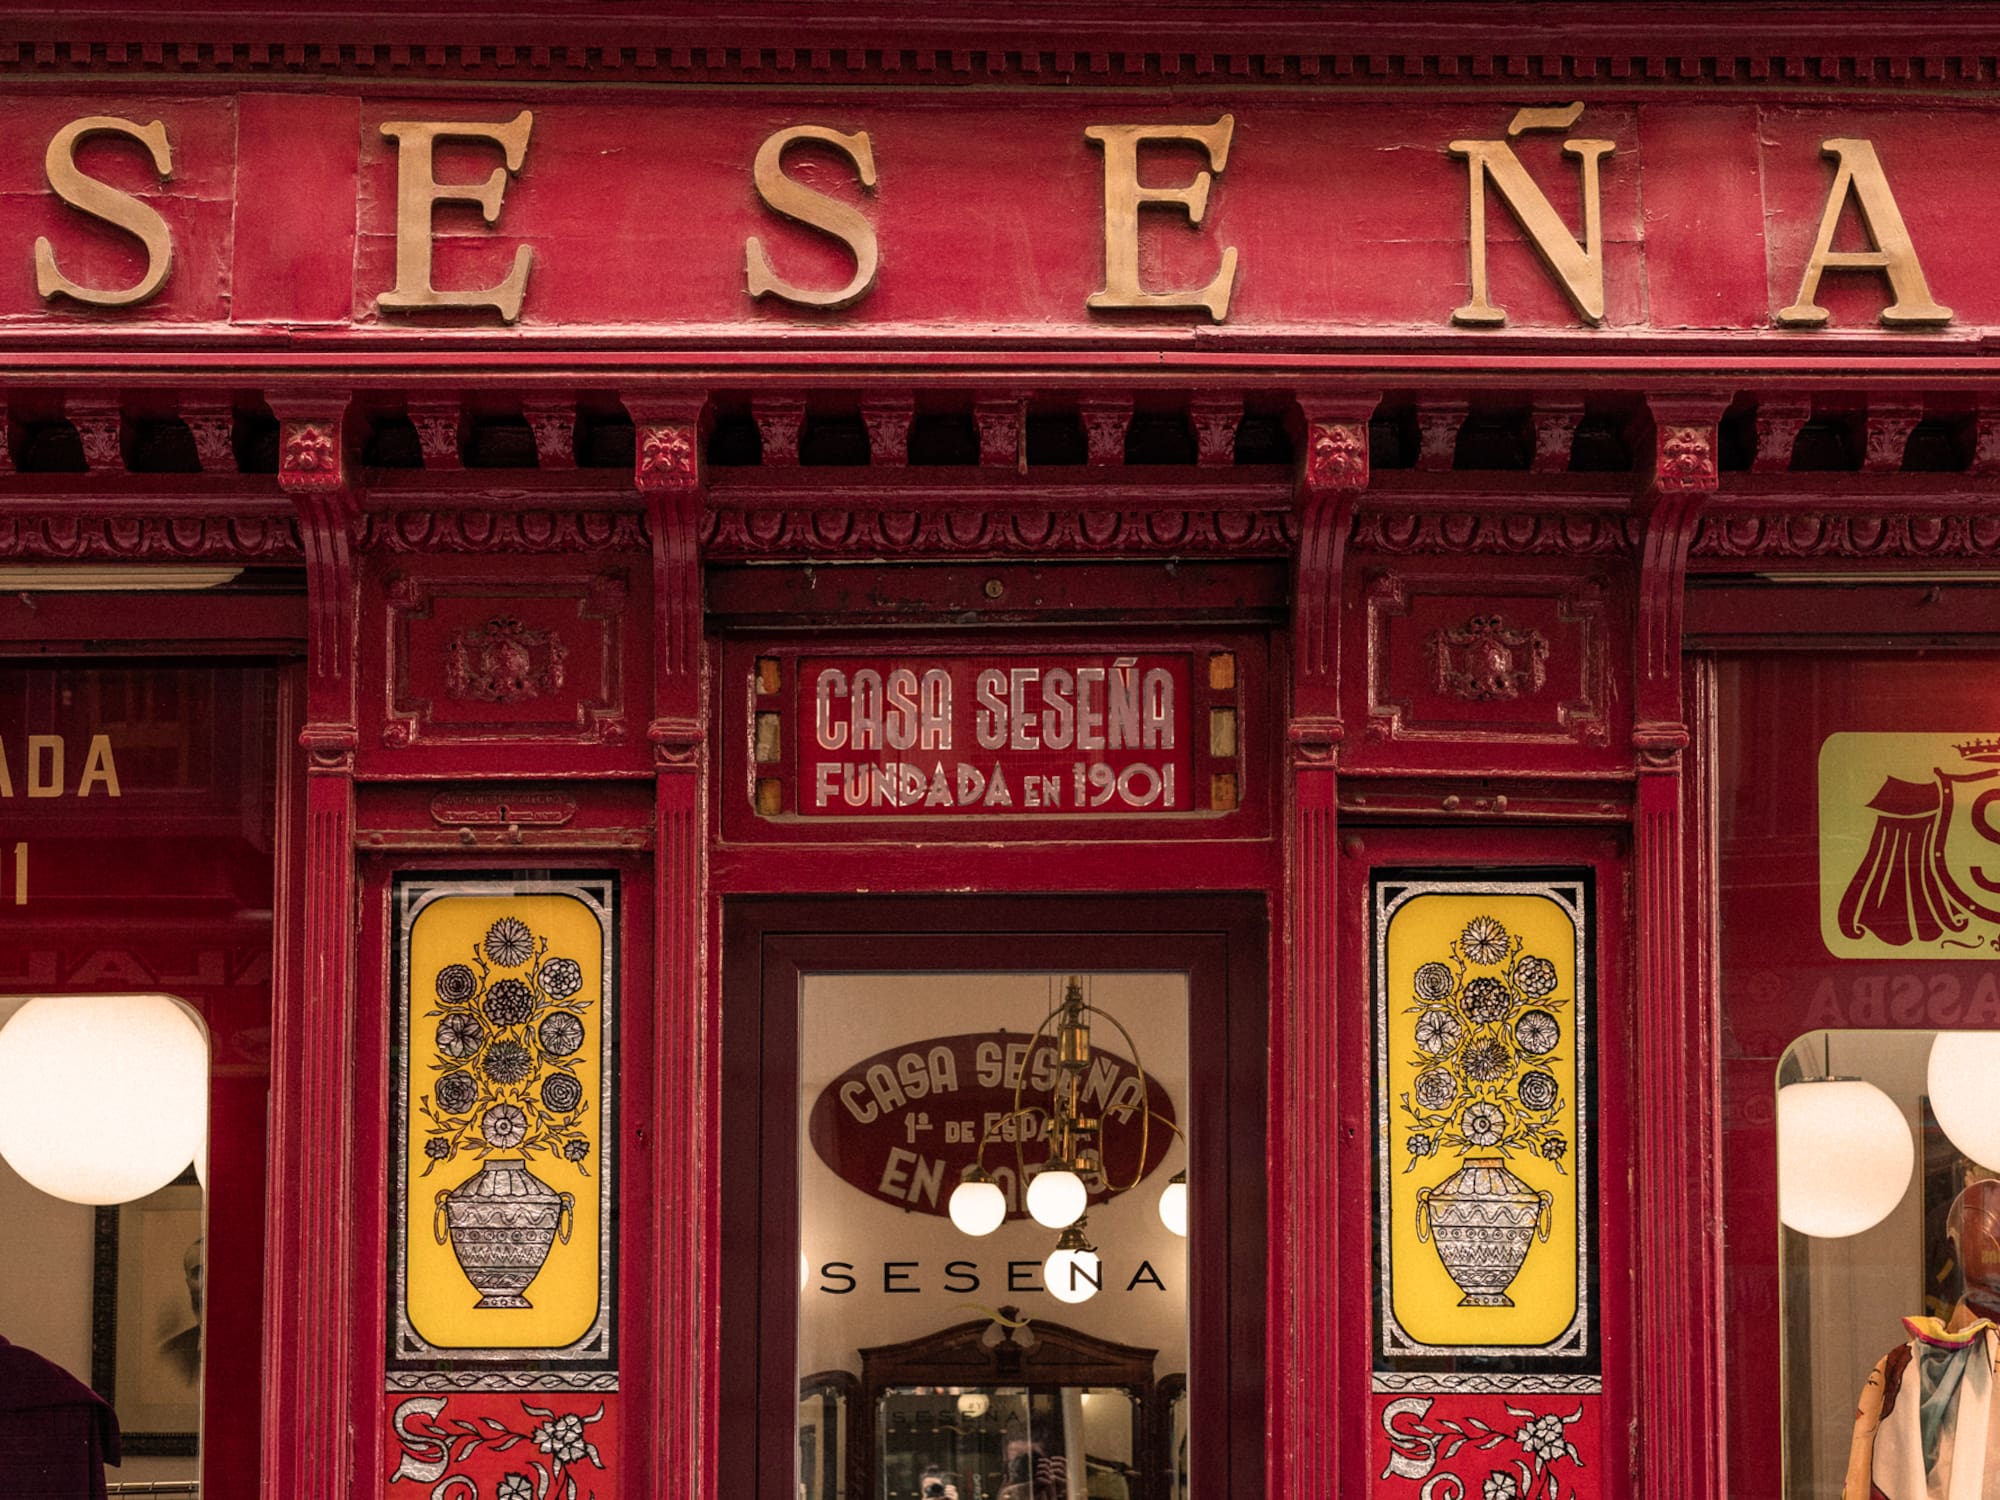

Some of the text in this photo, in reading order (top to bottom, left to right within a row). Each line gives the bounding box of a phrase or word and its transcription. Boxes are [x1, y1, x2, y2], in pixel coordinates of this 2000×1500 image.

[35, 101, 1953, 327] SESEÑA
[815, 657, 1175, 750] CASA SESEÑA
[815, 761, 1175, 807] FUNDADA EN 1901
[839, 1045, 958, 1125] CASA
[945, 1120, 976, 1144] DE
[878, 1146, 947, 1209] EN
[819, 1246, 1167, 1294] SESEÑA
